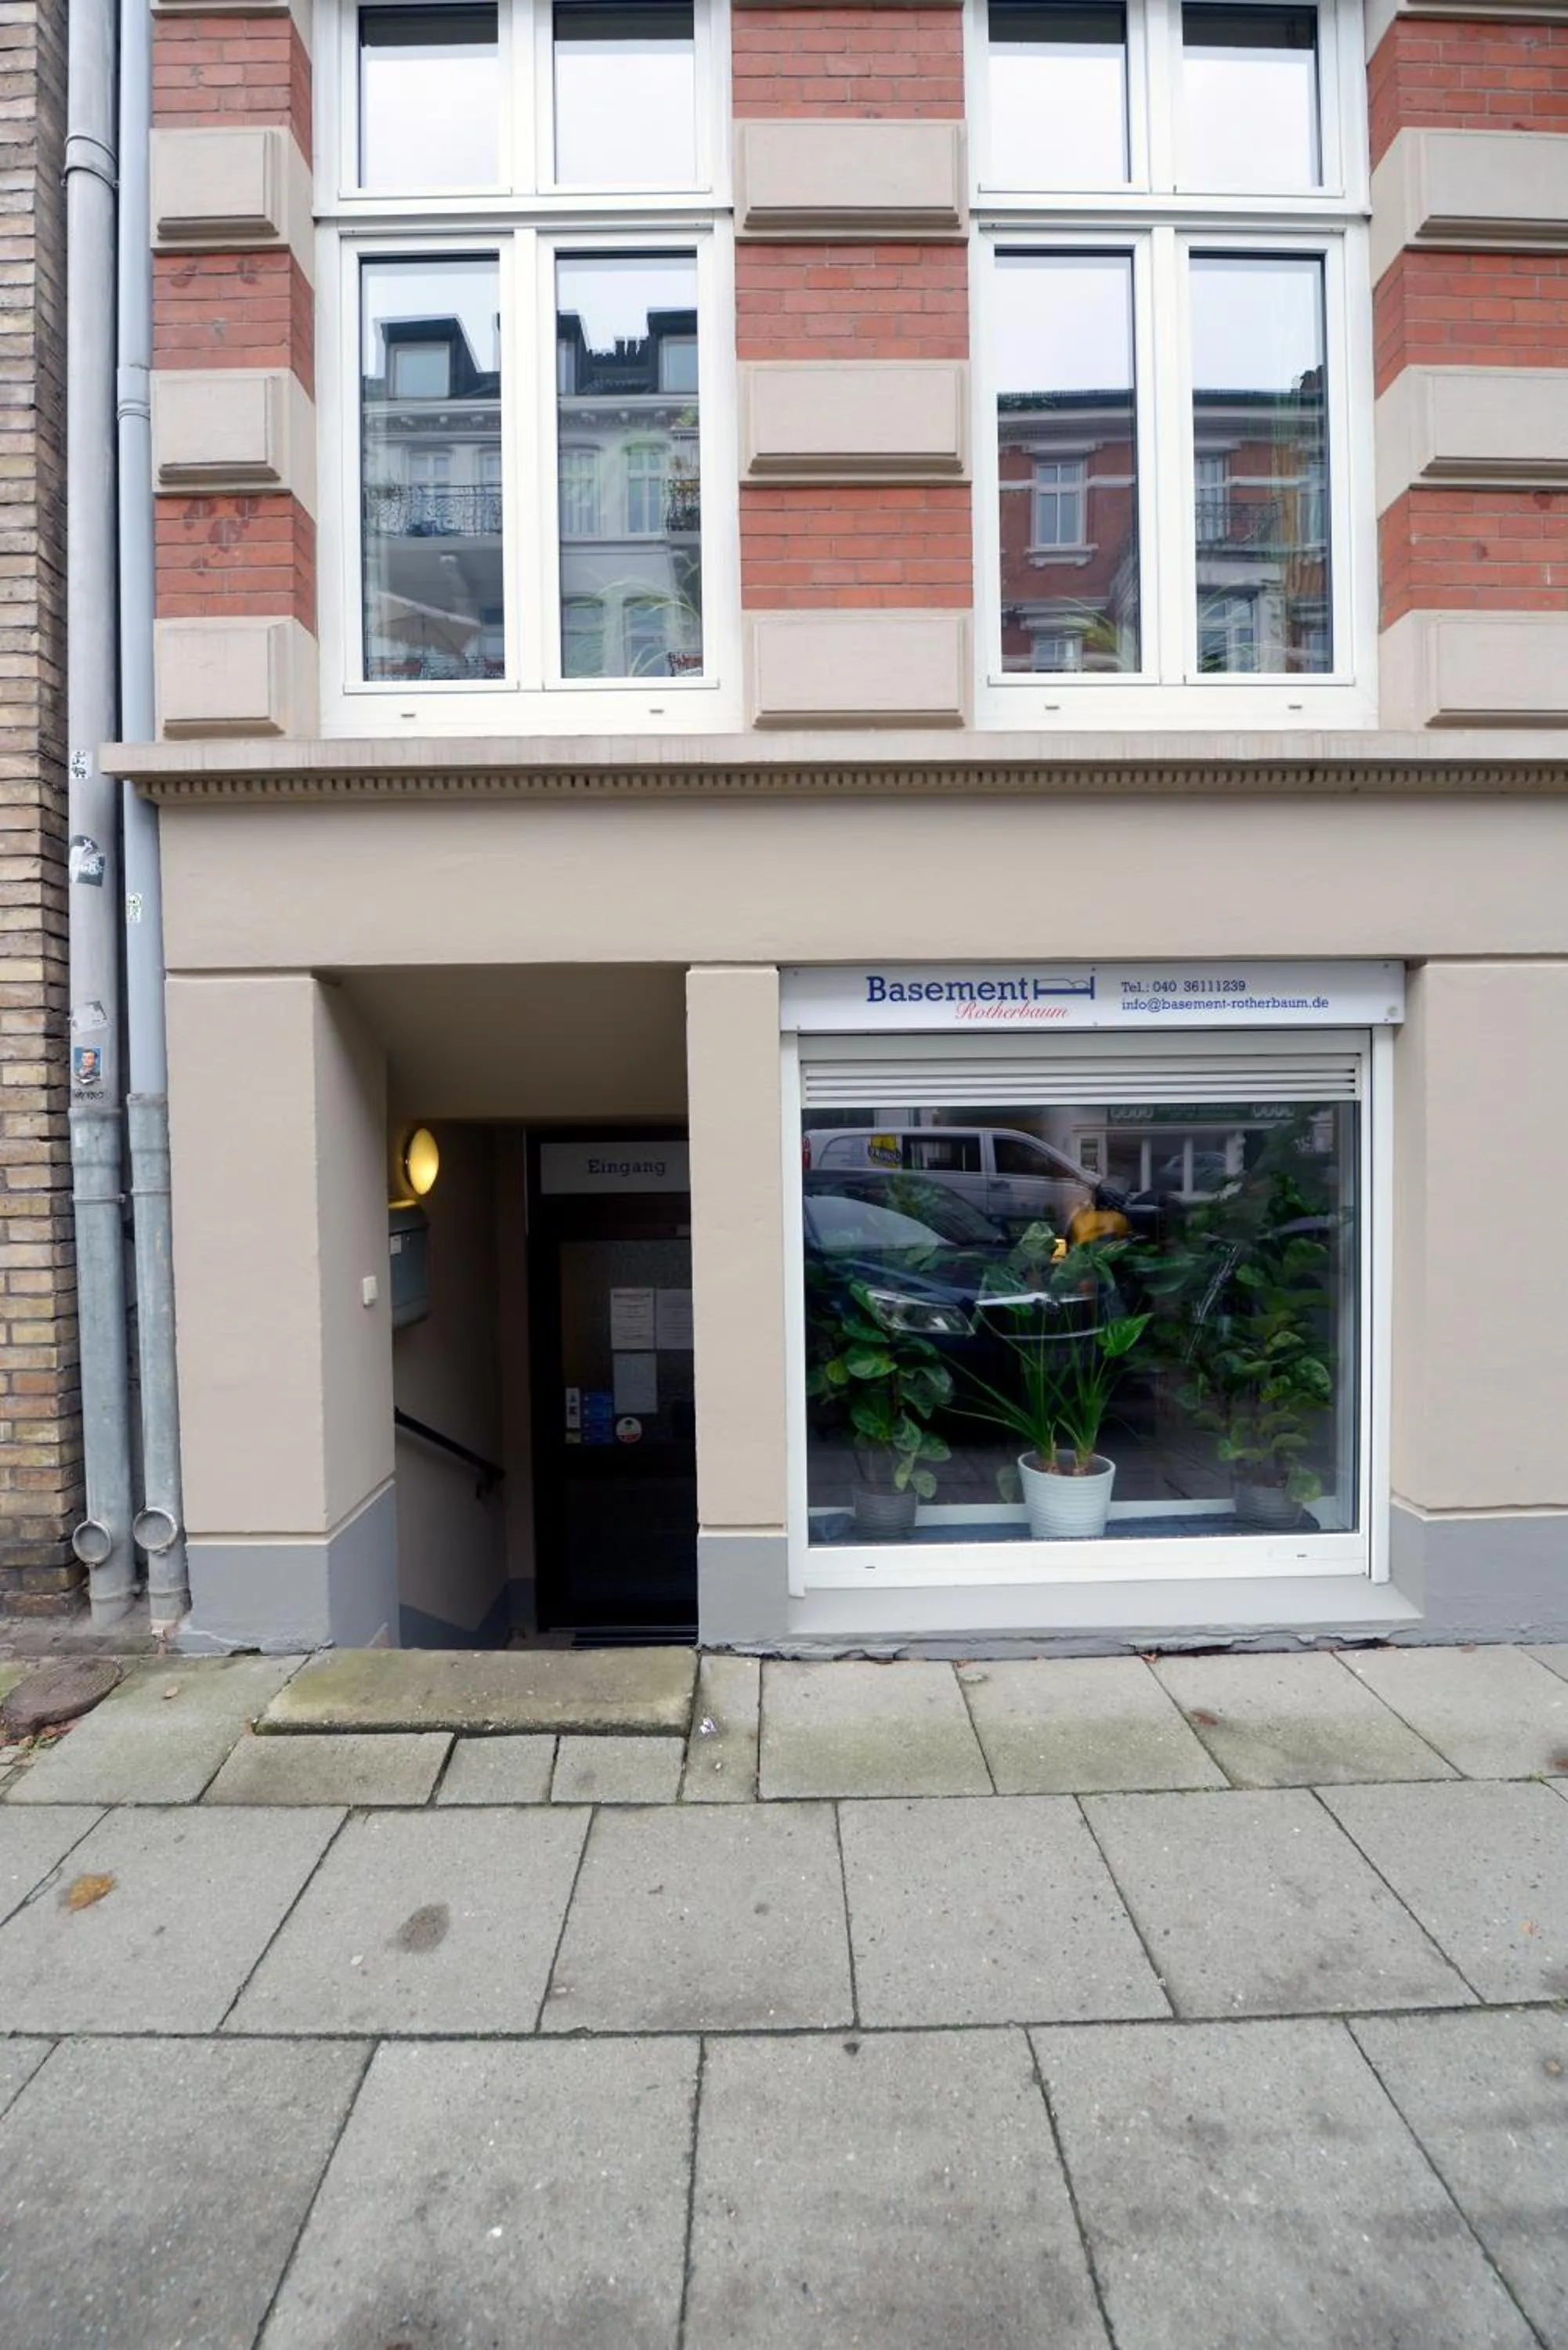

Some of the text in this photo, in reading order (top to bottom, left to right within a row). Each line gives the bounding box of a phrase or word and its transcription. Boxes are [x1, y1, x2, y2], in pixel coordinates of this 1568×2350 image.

[865, 976, 1028, 1002] Basement
[1122, 980, 1246, 992] Tel.: 040 36111239
[955, 999, 1069, 1020] Rotherbaum
[1122, 996, 1329, 1013] info@basement-rotherbaum.de
[587, 1159, 666, 1177] Eingang
